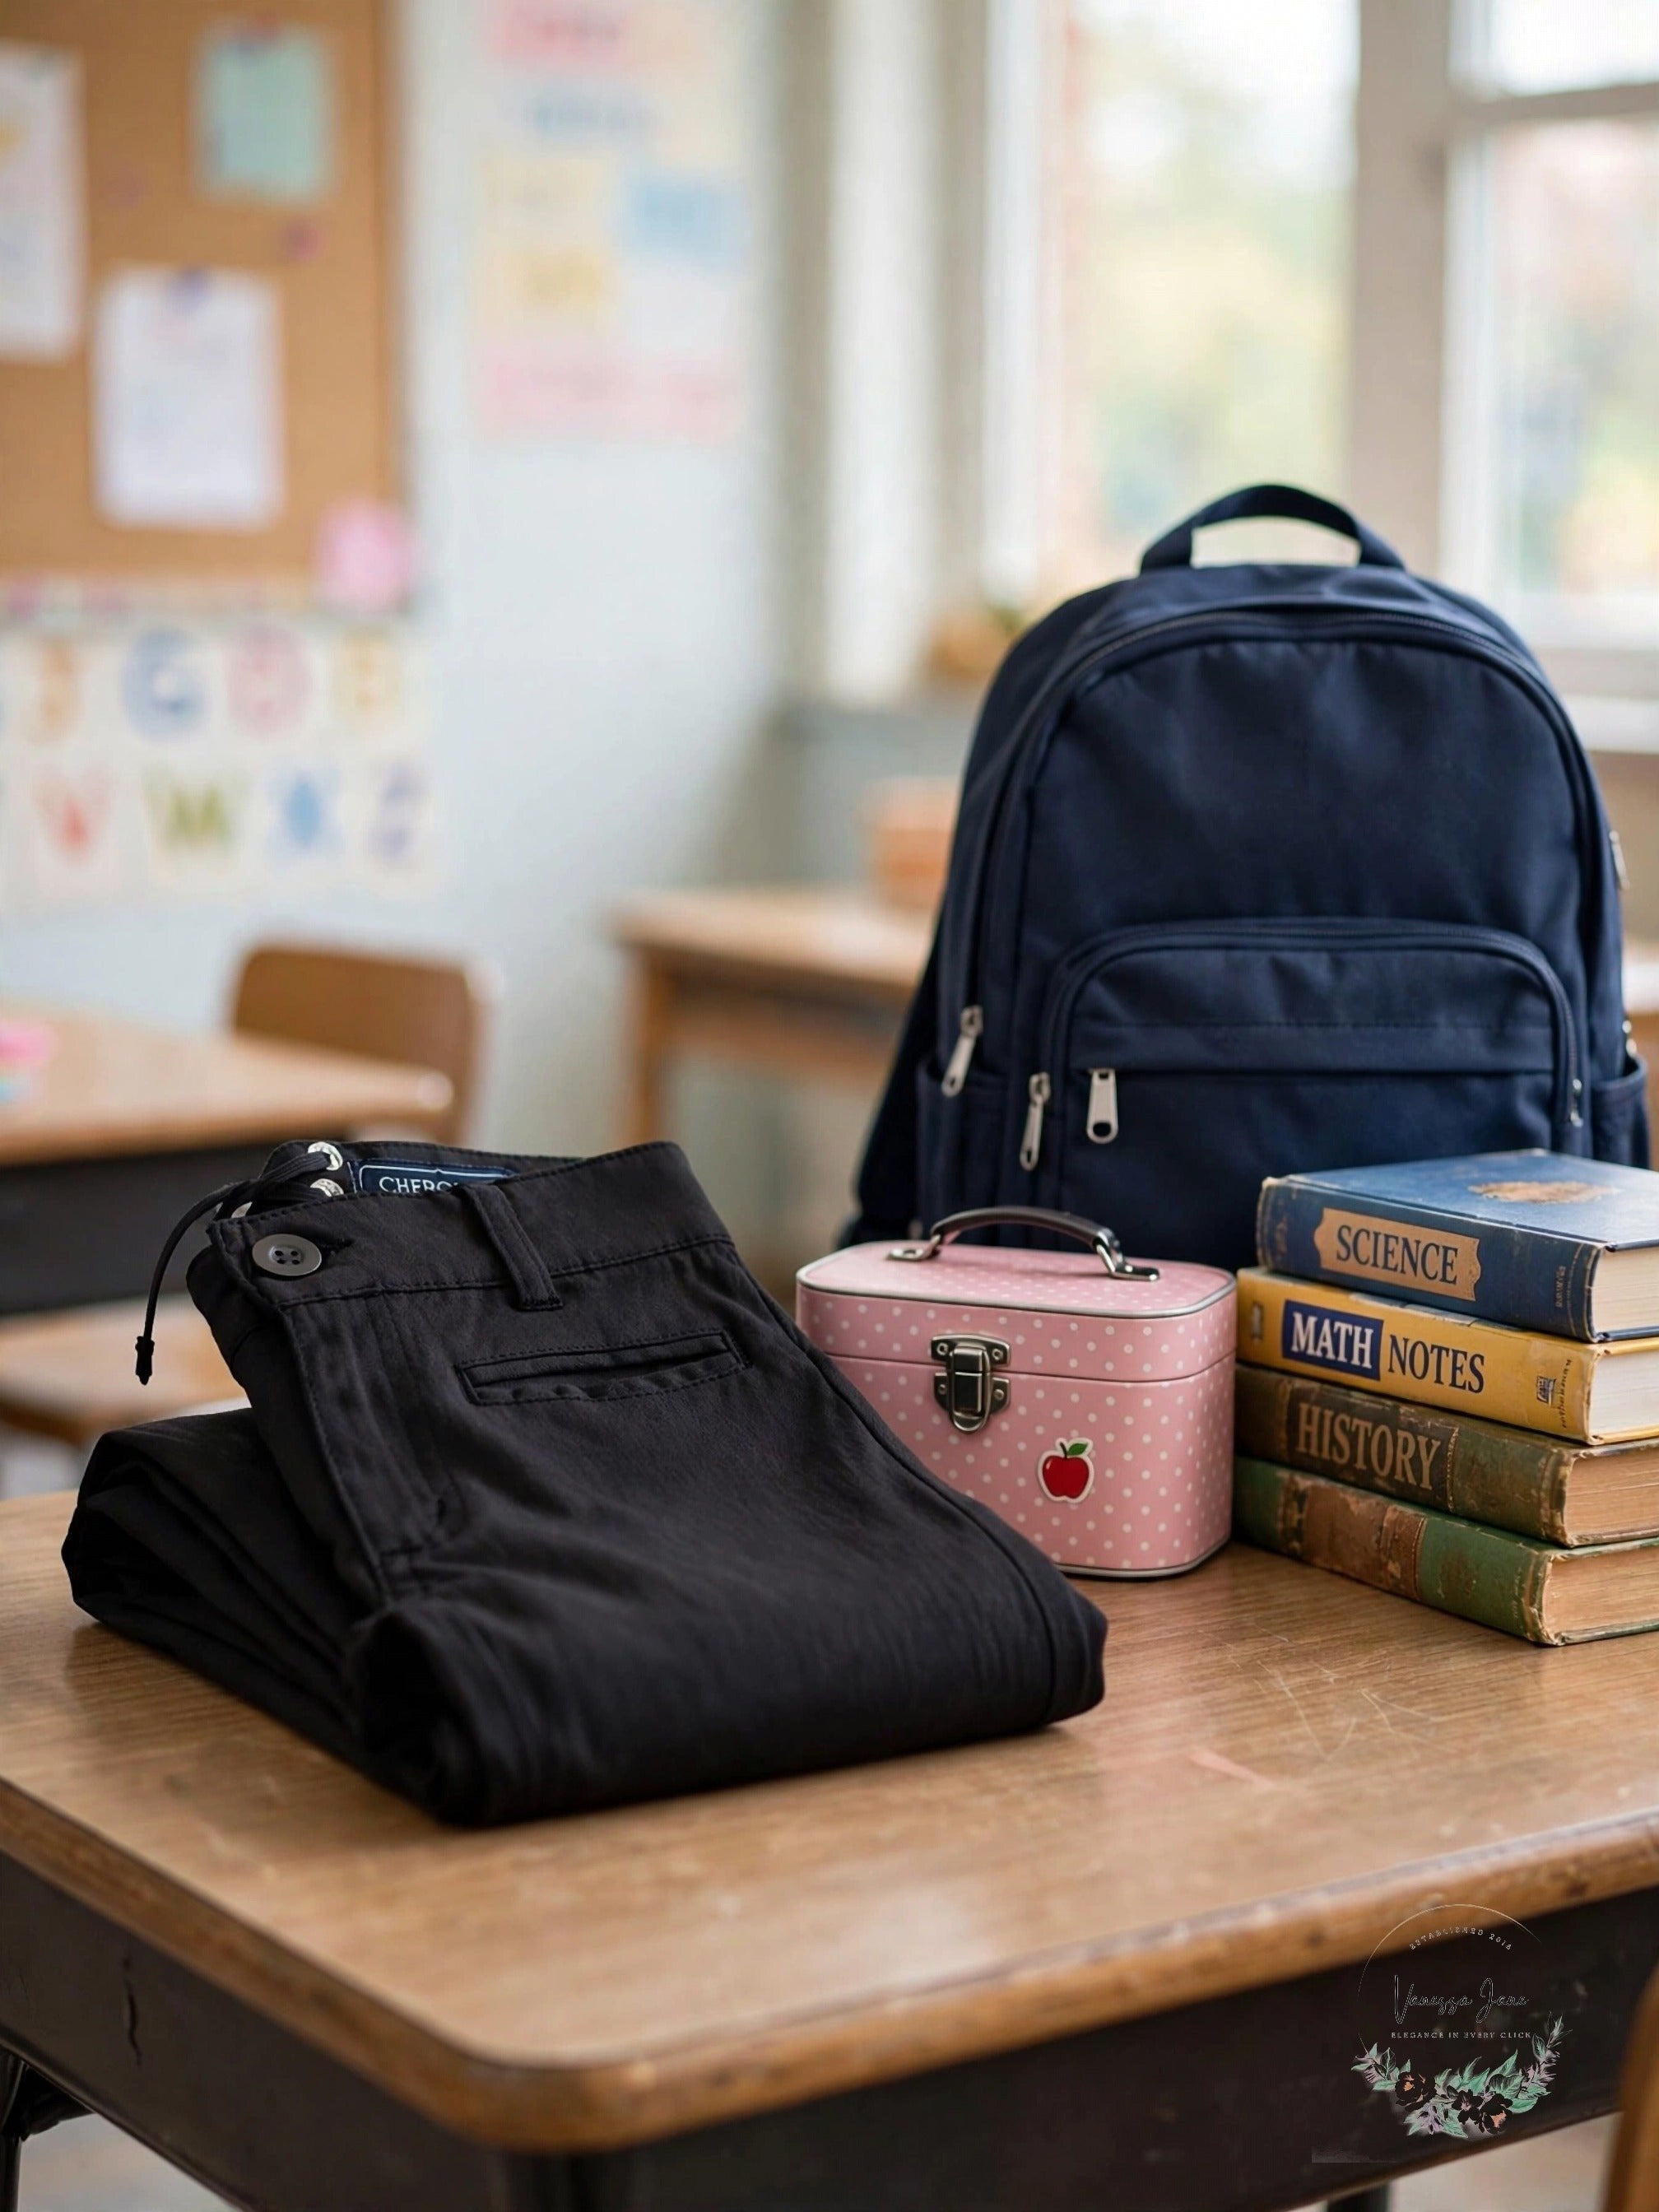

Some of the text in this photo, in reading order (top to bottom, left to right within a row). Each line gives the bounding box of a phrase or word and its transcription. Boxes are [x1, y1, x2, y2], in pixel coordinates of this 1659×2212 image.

[1336, 1224, 1458, 1285] SCIENCE
[1290, 1312, 1373, 1369] MATH
[1387, 1334, 1485, 1394] NOTES
[1295, 1402, 1440, 1490] HISTORY
